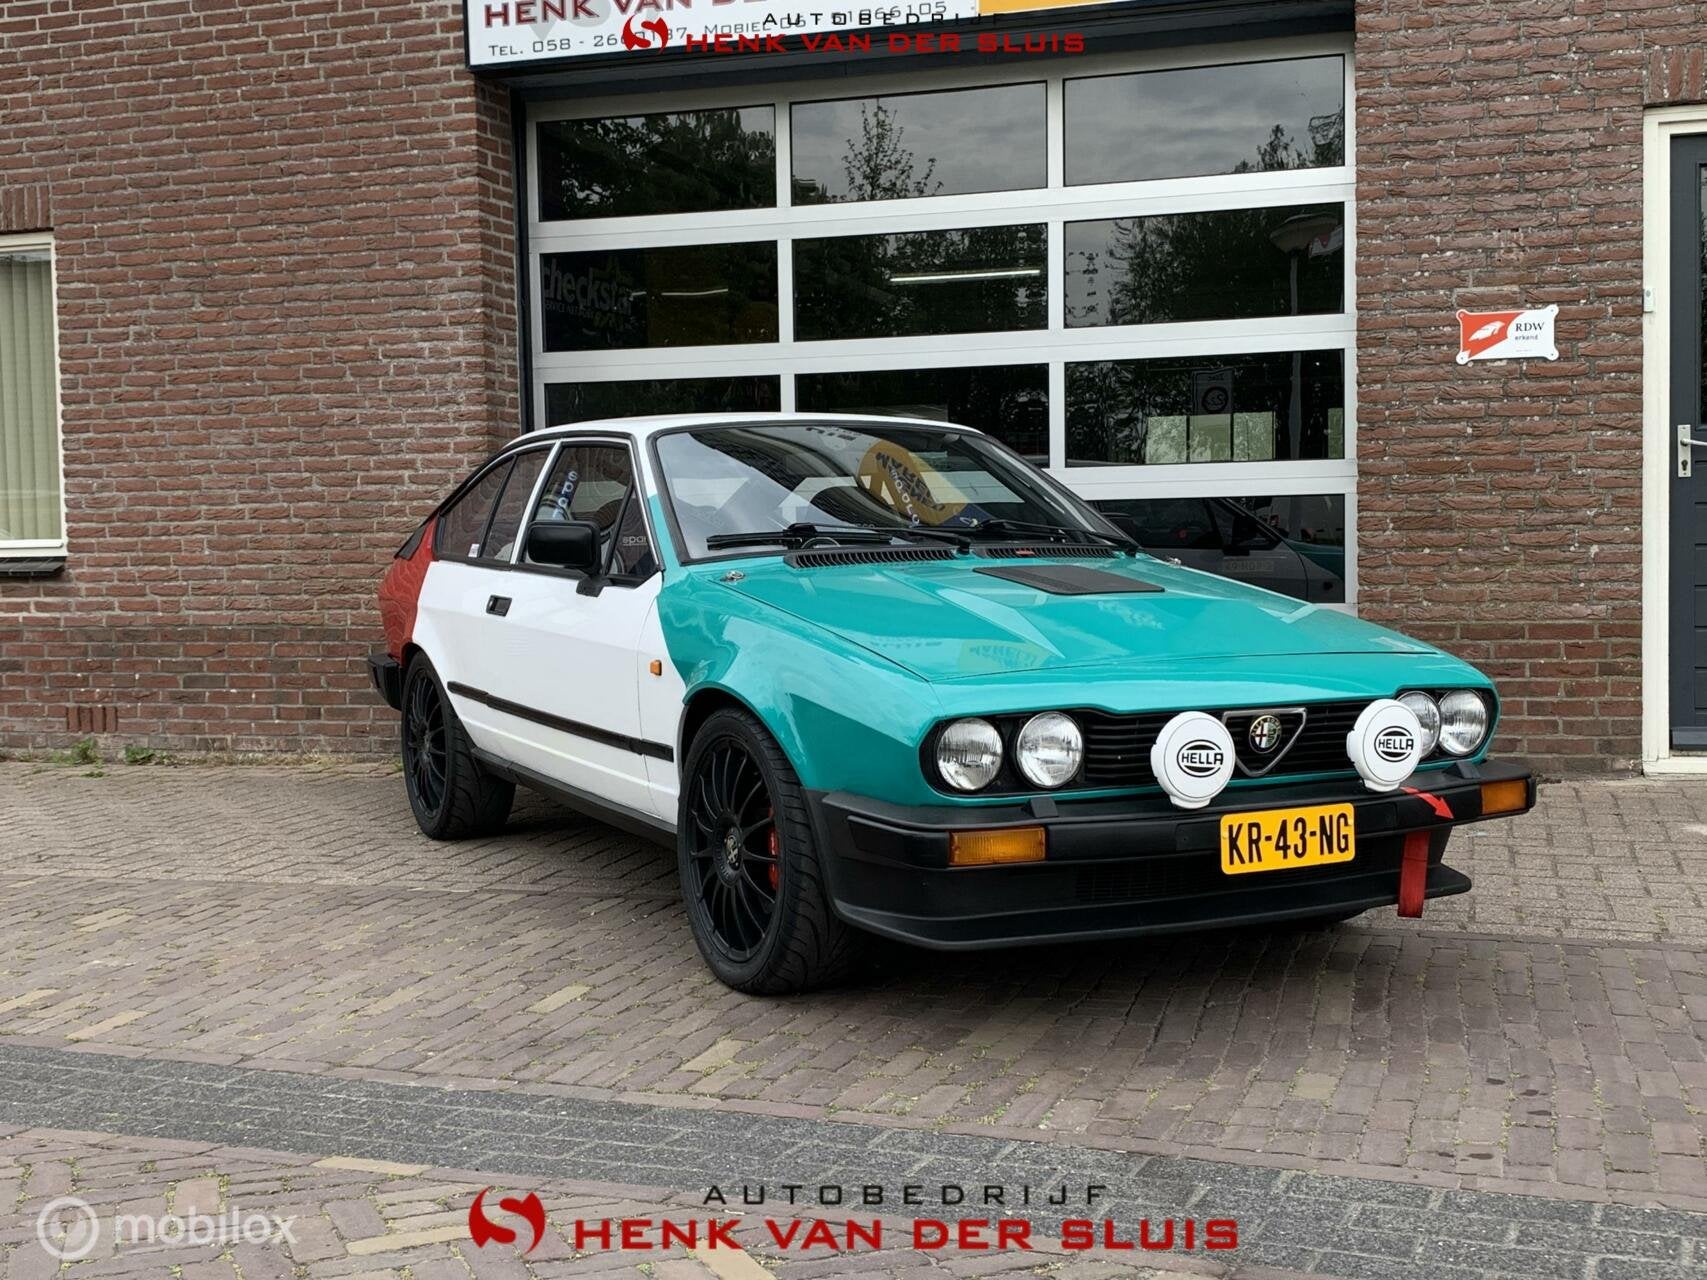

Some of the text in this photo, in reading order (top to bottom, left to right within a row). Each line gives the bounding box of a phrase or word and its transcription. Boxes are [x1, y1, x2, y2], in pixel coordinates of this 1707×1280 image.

[483, 0, 600, 28] HENK
[532, 38, 571, 53] 058
[1516, 321, 1545, 332] RDW
[1379, 738, 1414, 751] HELLA
[1181, 752, 1224, 765] HELLA
[1228, 812, 1350, 866] KR-43-NG
